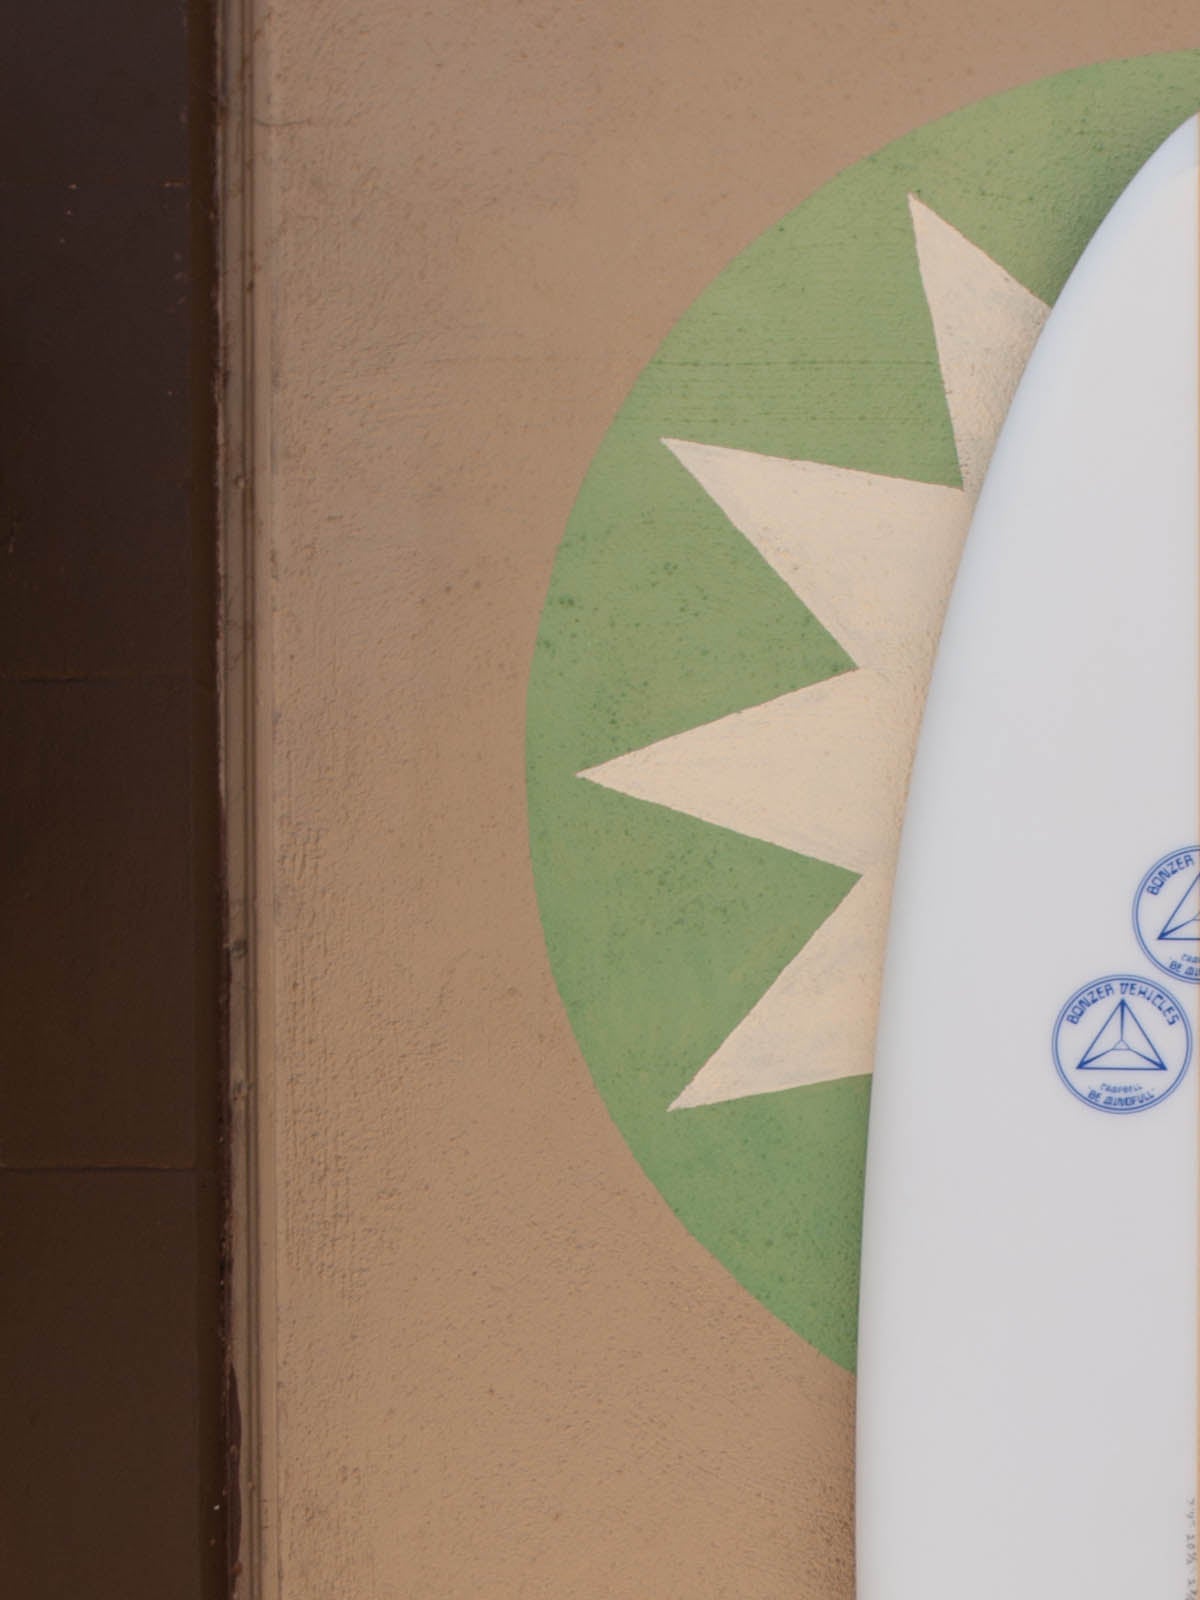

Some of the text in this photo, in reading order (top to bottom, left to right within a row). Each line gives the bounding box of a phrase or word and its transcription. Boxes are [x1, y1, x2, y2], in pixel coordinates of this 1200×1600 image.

[1146, 854, 1194, 896] BONZER
[1066, 982, 1180, 1026] BONZER VEHICLES
